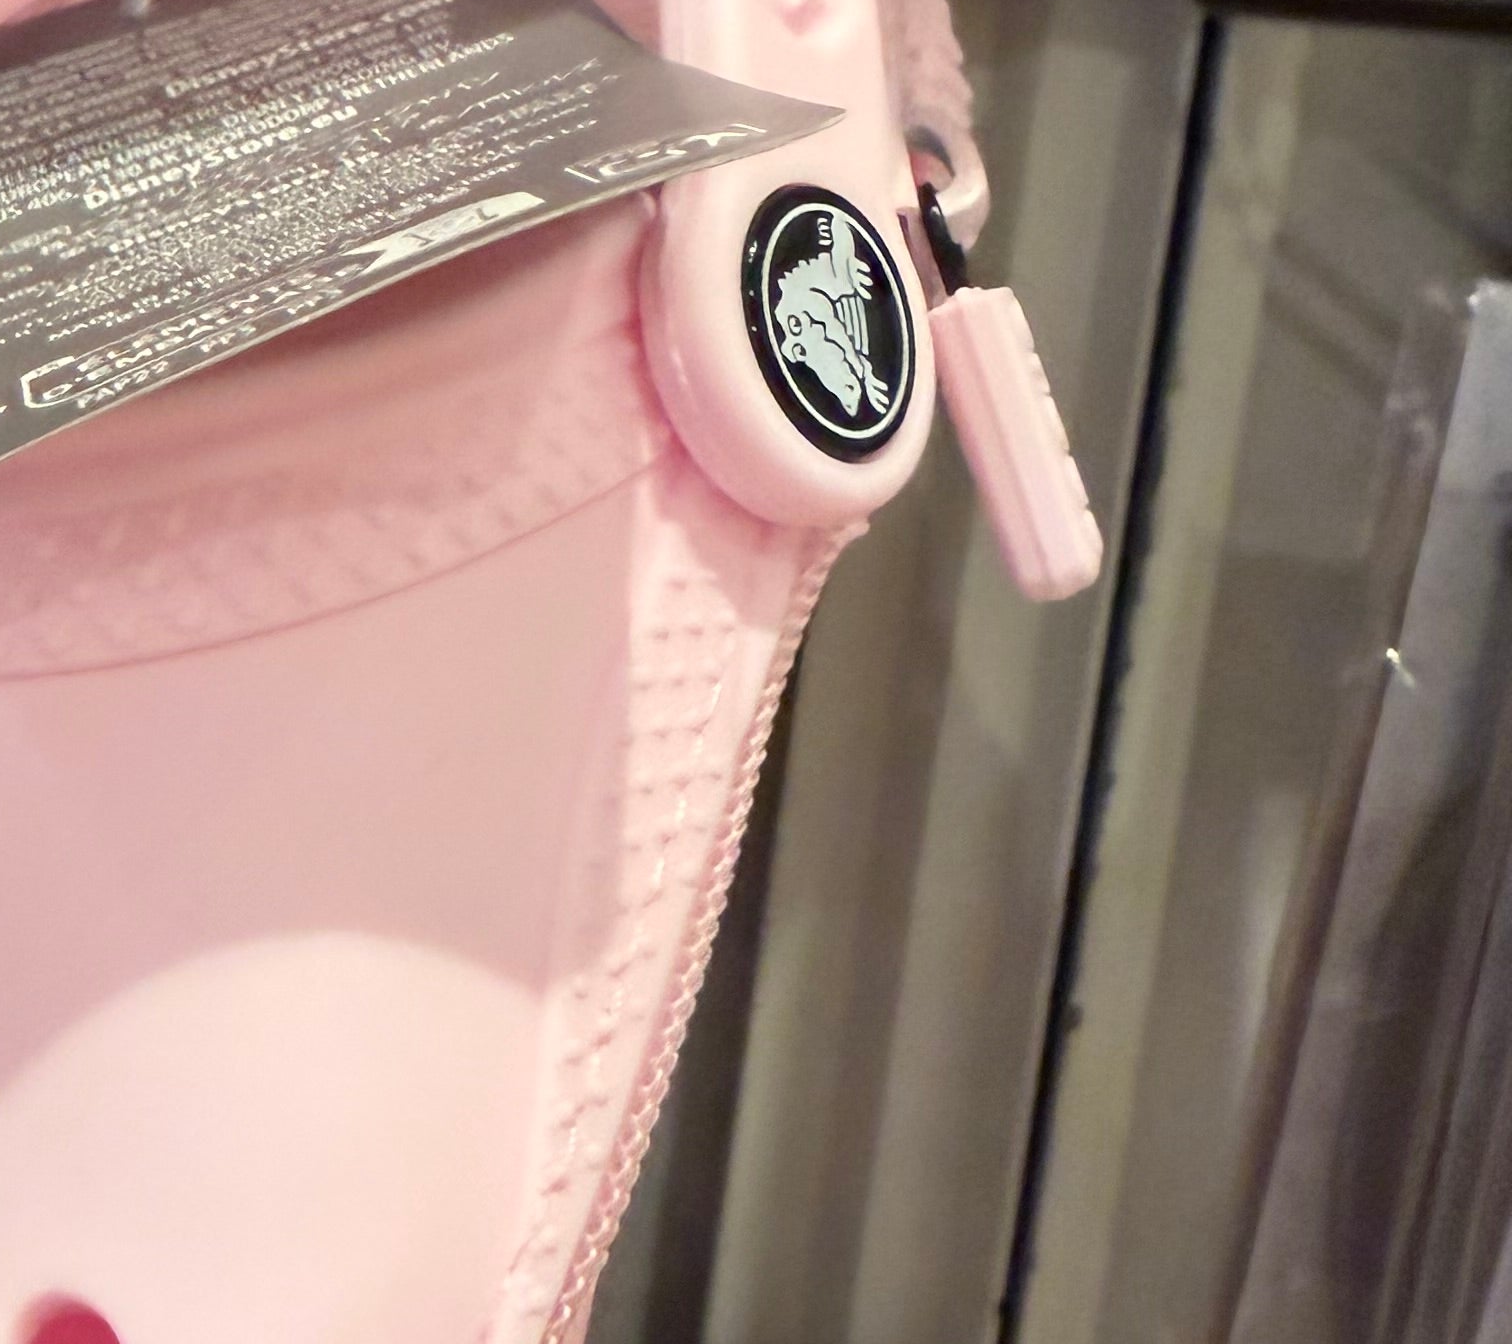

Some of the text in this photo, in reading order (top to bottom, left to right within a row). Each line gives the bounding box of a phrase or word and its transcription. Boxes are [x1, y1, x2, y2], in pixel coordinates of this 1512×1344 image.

[341, 29, 514, 104] NETHERLANDS
[84, 101, 357, 212] DisneyStore.eu
[117, 126, 193, 165] UNION
